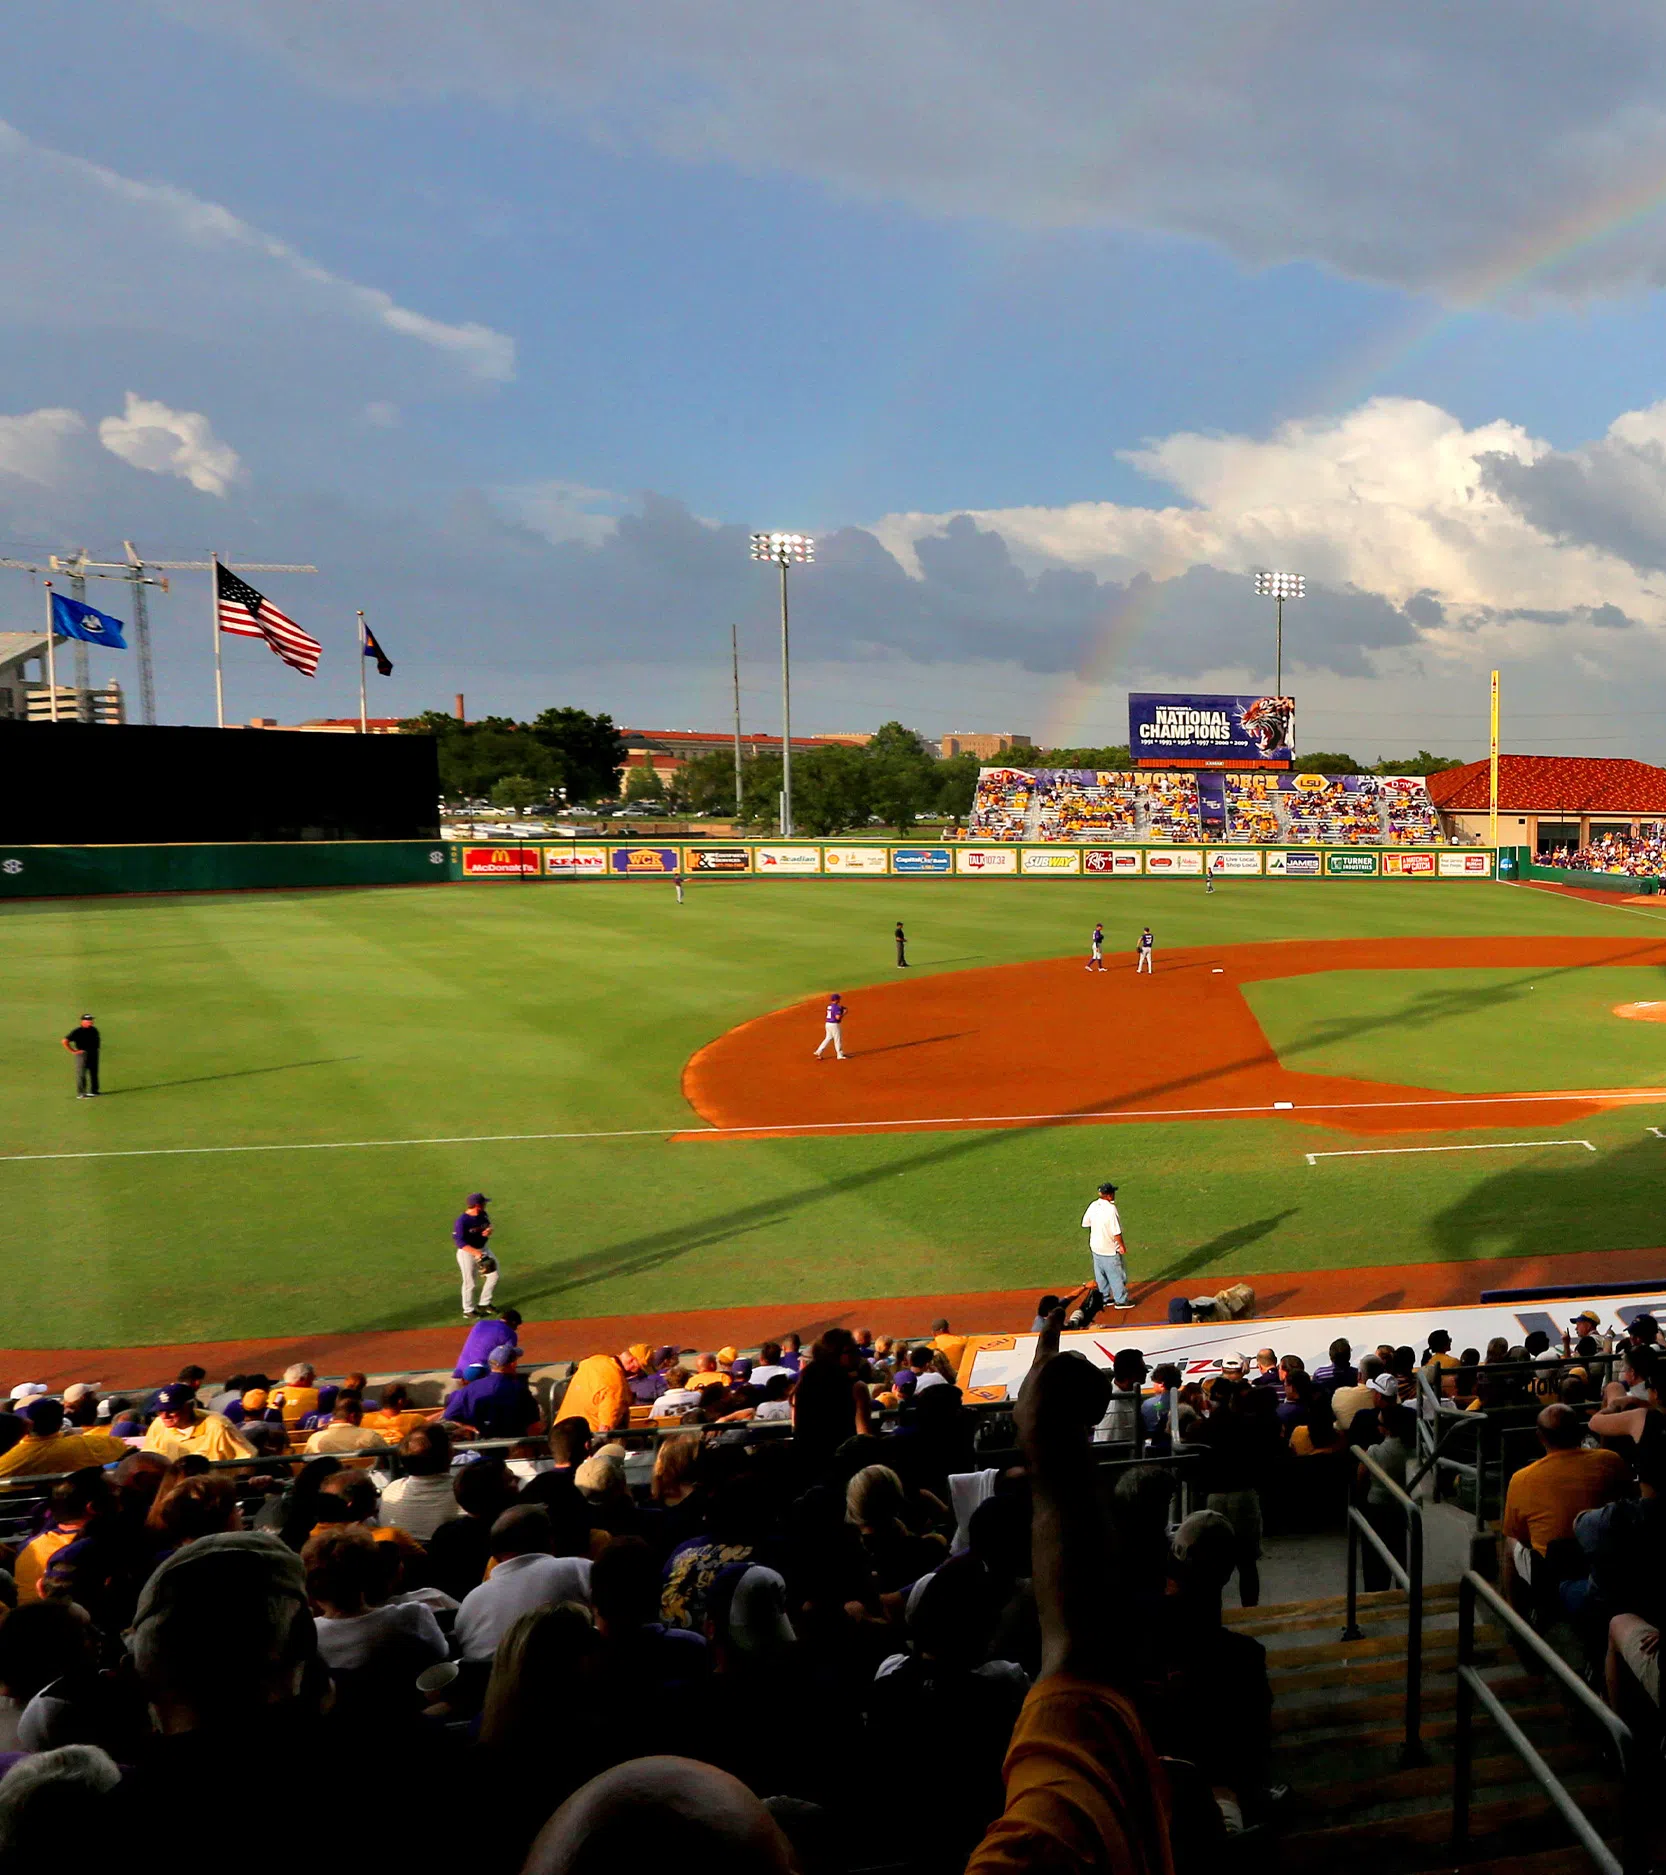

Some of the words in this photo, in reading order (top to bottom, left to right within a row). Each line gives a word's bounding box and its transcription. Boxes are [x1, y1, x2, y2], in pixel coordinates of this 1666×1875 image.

[1156, 711, 1230, 726] NATIONAL
[1139, 724, 1230, 740] CHAMPIONS
[1300, 778, 1321, 788] LSU
[629, 855, 661, 864] WCK
[1026, 855, 1074, 866] SUBWAY
[1287, 859, 1319, 867] JAMES
[1412, 862, 1430, 870] CATCH
[979, 1338, 1010, 1350] LSU
[969, 1388, 999, 1400] LSU
